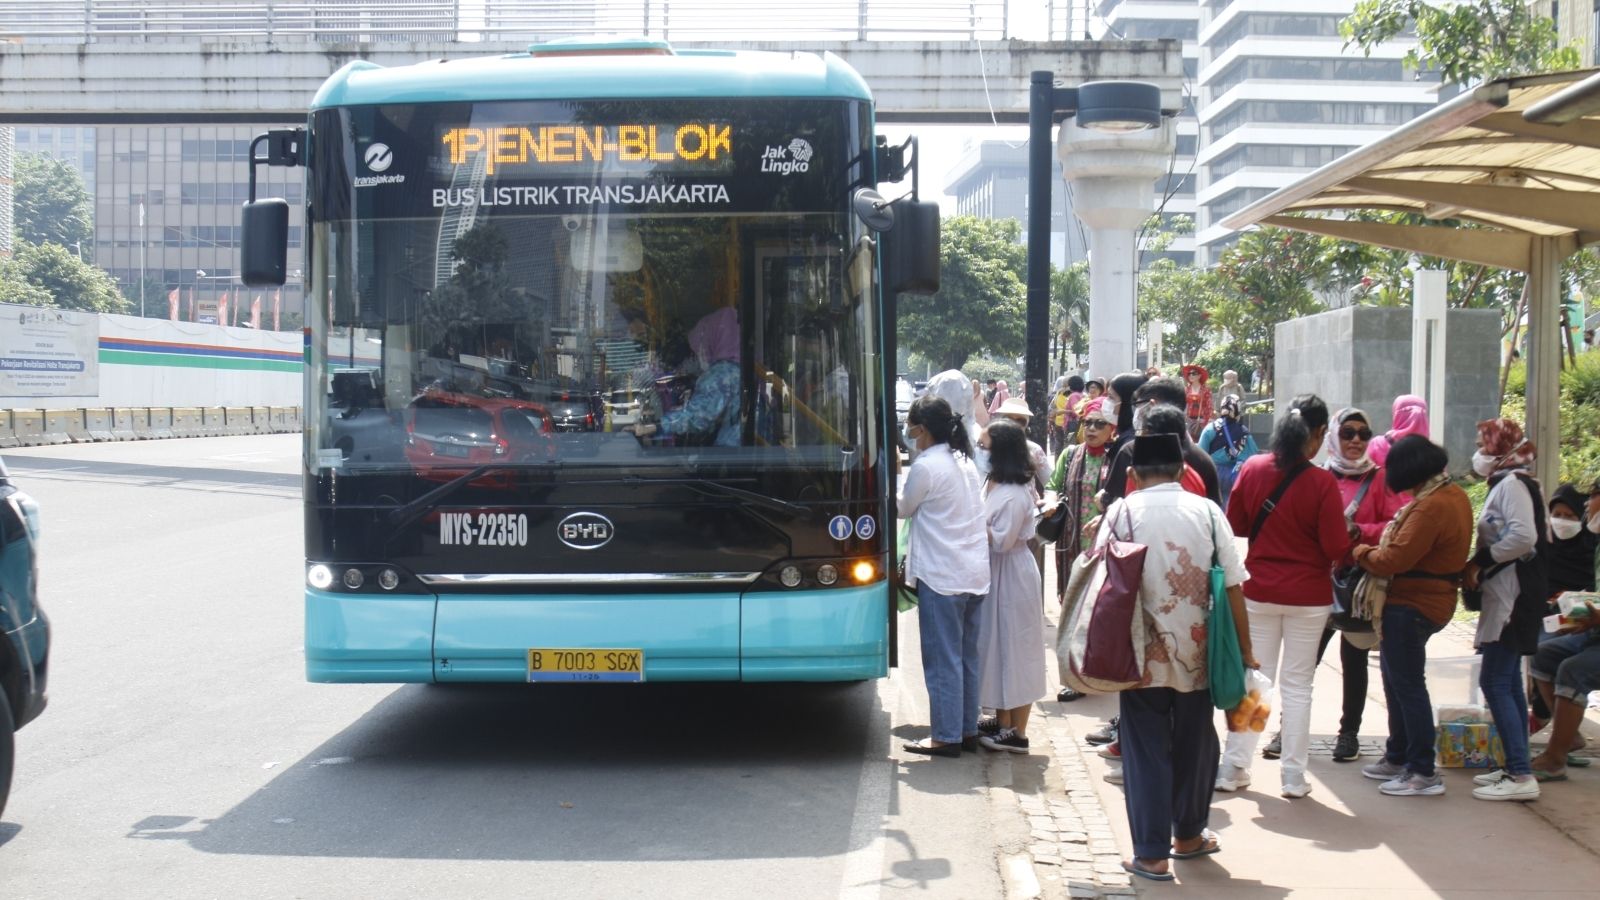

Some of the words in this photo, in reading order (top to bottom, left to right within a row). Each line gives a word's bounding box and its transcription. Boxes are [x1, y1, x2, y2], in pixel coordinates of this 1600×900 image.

[761, 145, 786, 160] Jak
[761, 160, 809, 176] Lingko
[354, 174, 405, 187] transjakarta
[432, 188, 474, 208] BUS
[480, 186, 559, 206] LISTRIK
[563, 185, 731, 205] TRANSJAKARTA
[440, 513, 528, 547] MYS-22350
[563, 523, 608, 539] BYD
[532, 652, 542, 670] B
[554, 652, 595, 671] 7003
[607, 652, 639, 671] SGX
